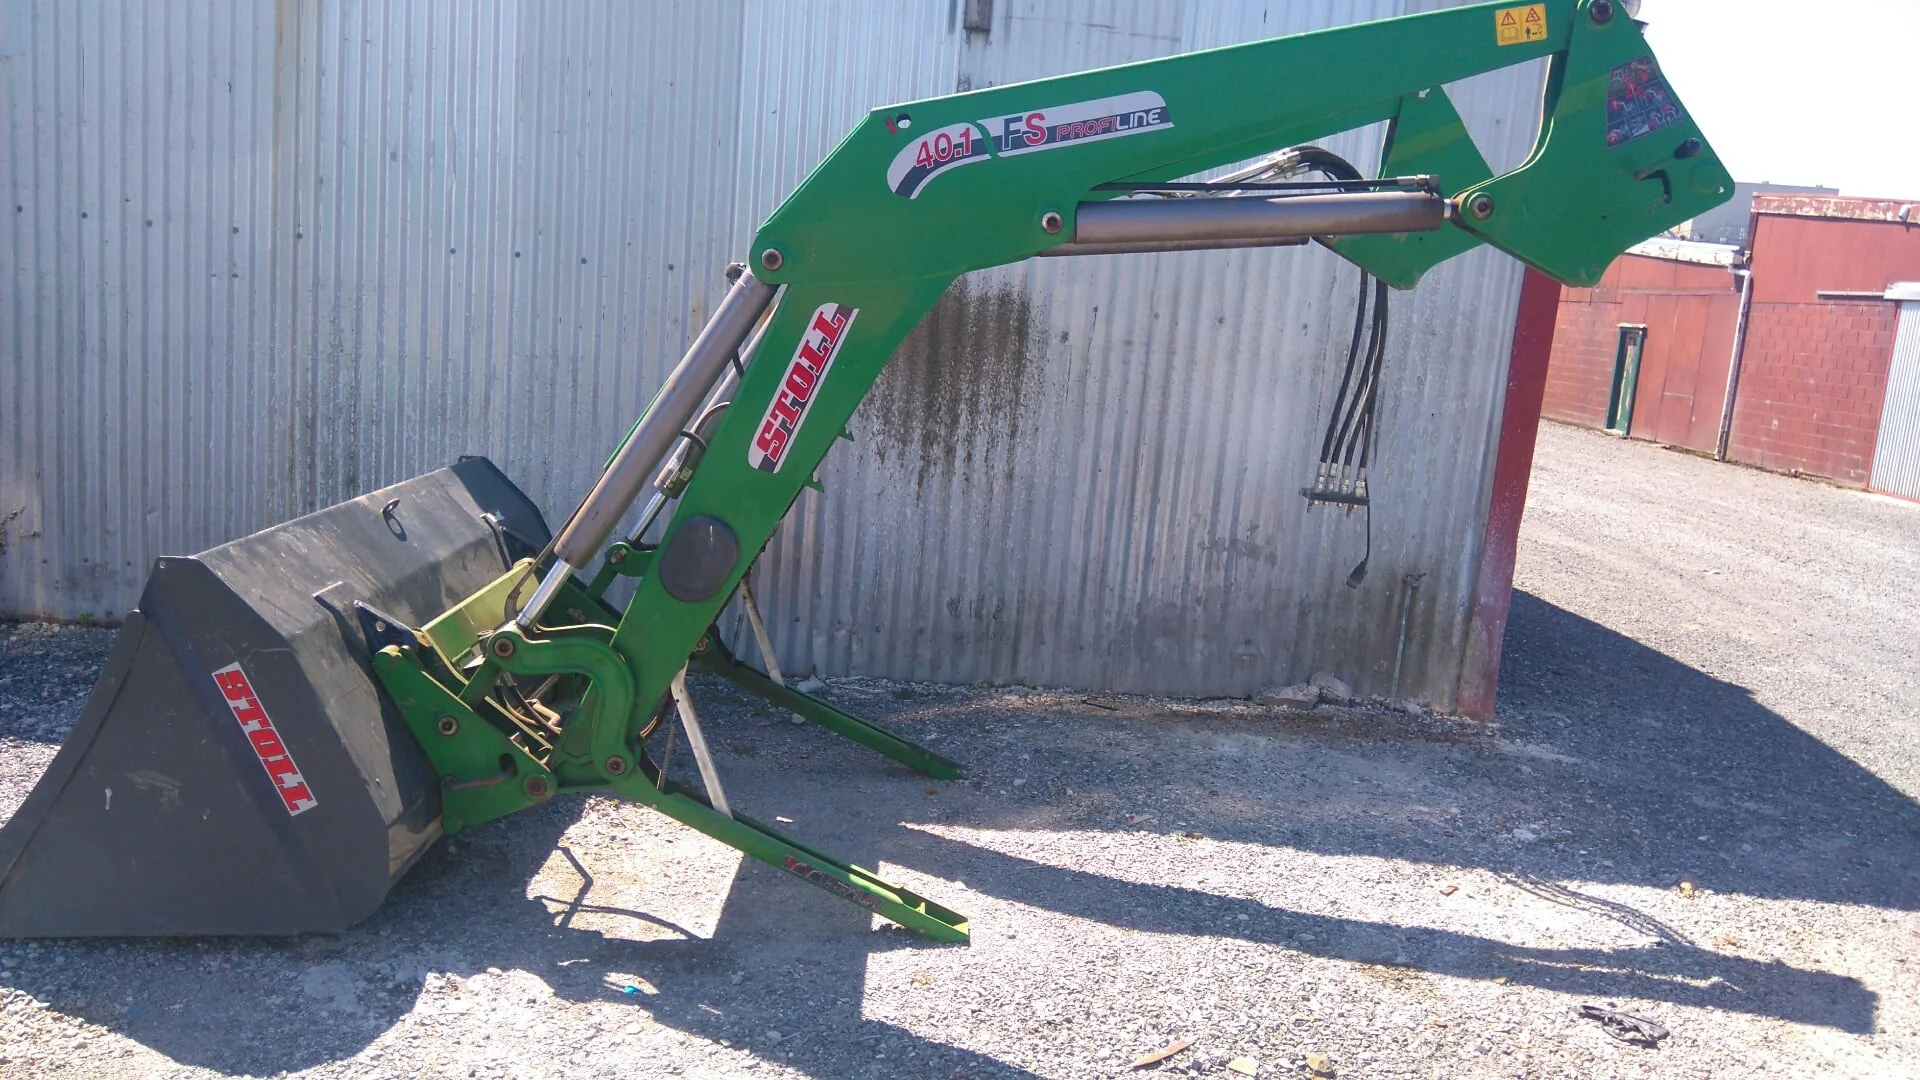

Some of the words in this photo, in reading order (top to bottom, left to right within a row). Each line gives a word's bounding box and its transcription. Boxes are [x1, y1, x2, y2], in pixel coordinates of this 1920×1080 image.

[915, 127, 972, 169] 40.1
[1001, 112, 1048, 150] FS
[756, 310, 846, 462] STOLL
[214, 669, 315, 812] STOLL
